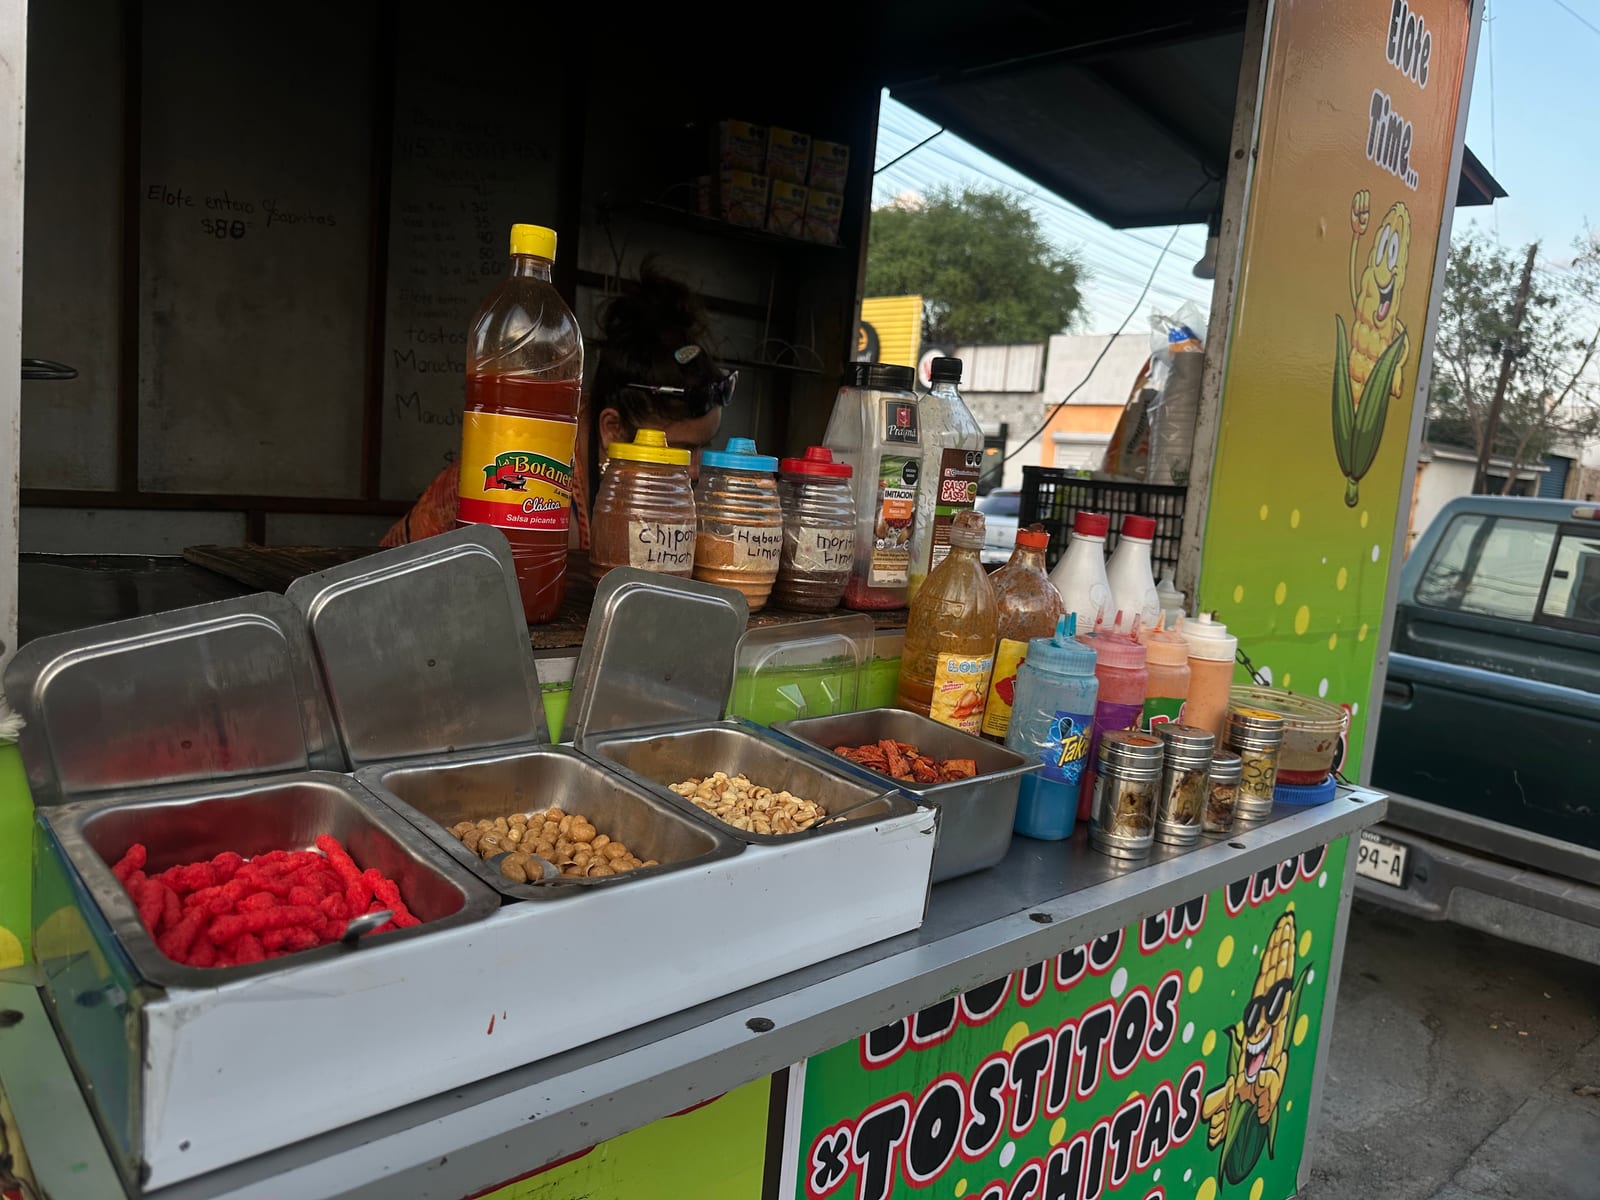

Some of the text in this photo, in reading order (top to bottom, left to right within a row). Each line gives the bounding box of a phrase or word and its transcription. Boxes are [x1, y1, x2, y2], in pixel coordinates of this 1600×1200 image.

[1386, 0, 1431, 89] Elote
[1367, 89, 1418, 190] Time...
[147, 184, 195, 208] Elote
[205, 190, 255, 215] entero
[884, 490, 913, 499] IMITACION
[506, 513, 529, 523] Salsa
[530, 515, 557, 525] picante
[1359, 845, 1400, 877] 94-A
[851, 974, 1182, 1200] TOSTITOS
